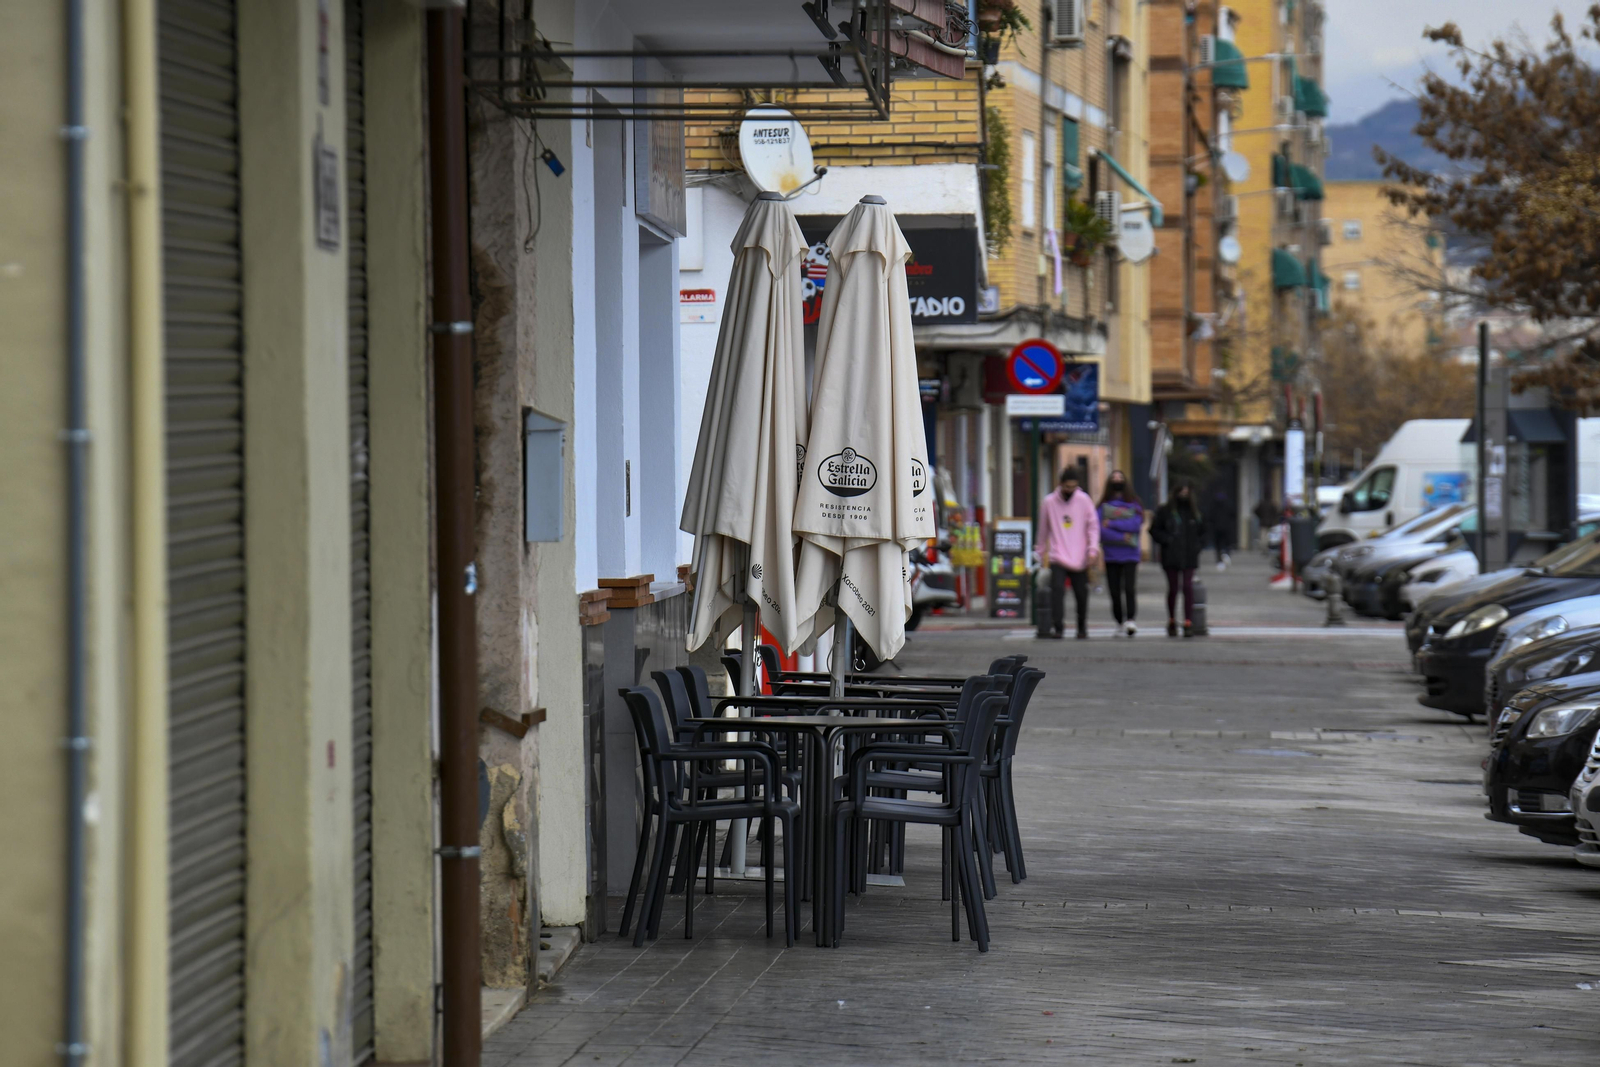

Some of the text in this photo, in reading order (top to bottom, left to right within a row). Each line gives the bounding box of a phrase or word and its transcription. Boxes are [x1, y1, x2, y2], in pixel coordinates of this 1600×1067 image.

[753, 128, 790, 138] ANTESUR
[680, 293, 713, 301] ALARMA
[827, 461, 870, 475] Estrella
[828, 473, 867, 487] Galicia
[820, 502, 871, 512] RESISTENCIA
[822, 512, 845, 520] DESDE
[842, 574, 876, 617] Xacobeo 2021
